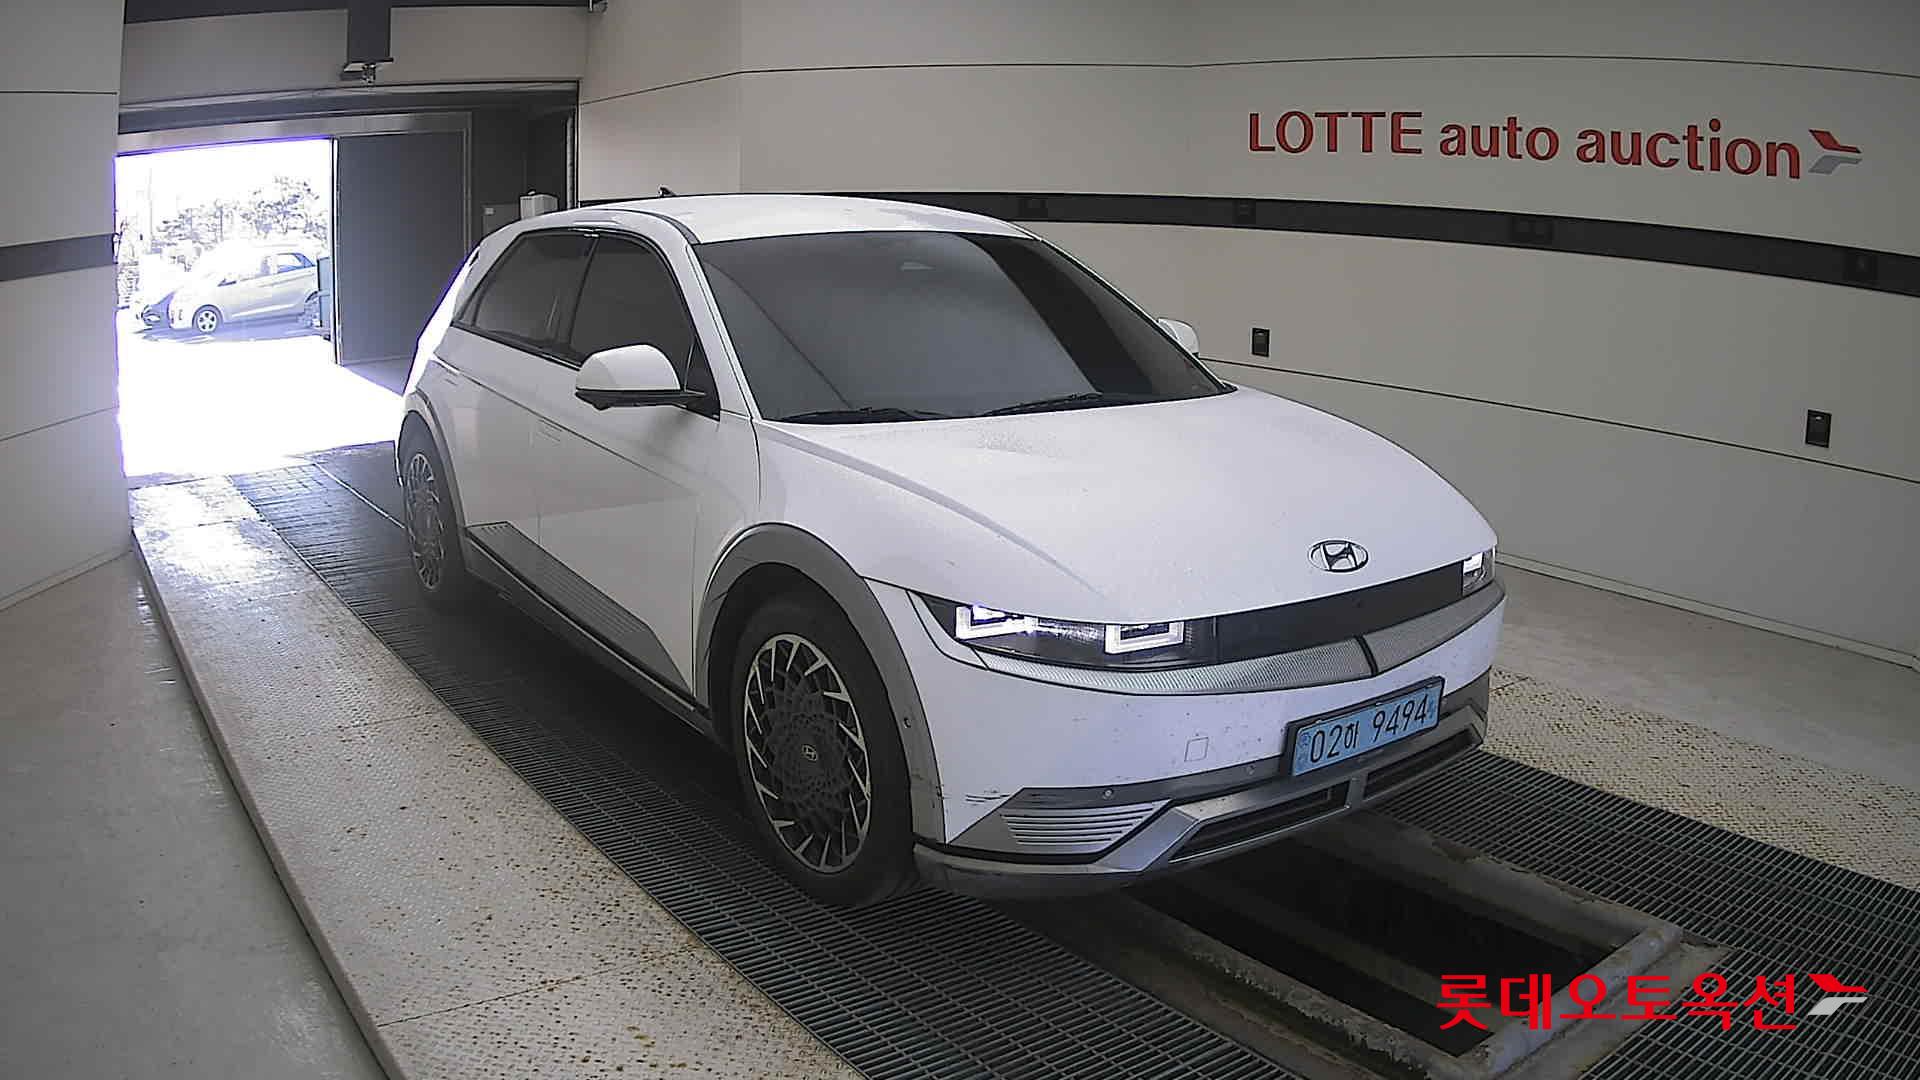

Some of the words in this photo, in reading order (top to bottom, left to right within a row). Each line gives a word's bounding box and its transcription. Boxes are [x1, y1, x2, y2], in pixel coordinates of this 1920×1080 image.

[1248, 111, 1423, 154] LOTTE
[1440, 116, 1560, 161] auto
[1577, 118, 1801, 179] auction
[1373, 694, 1429, 743] 9494
